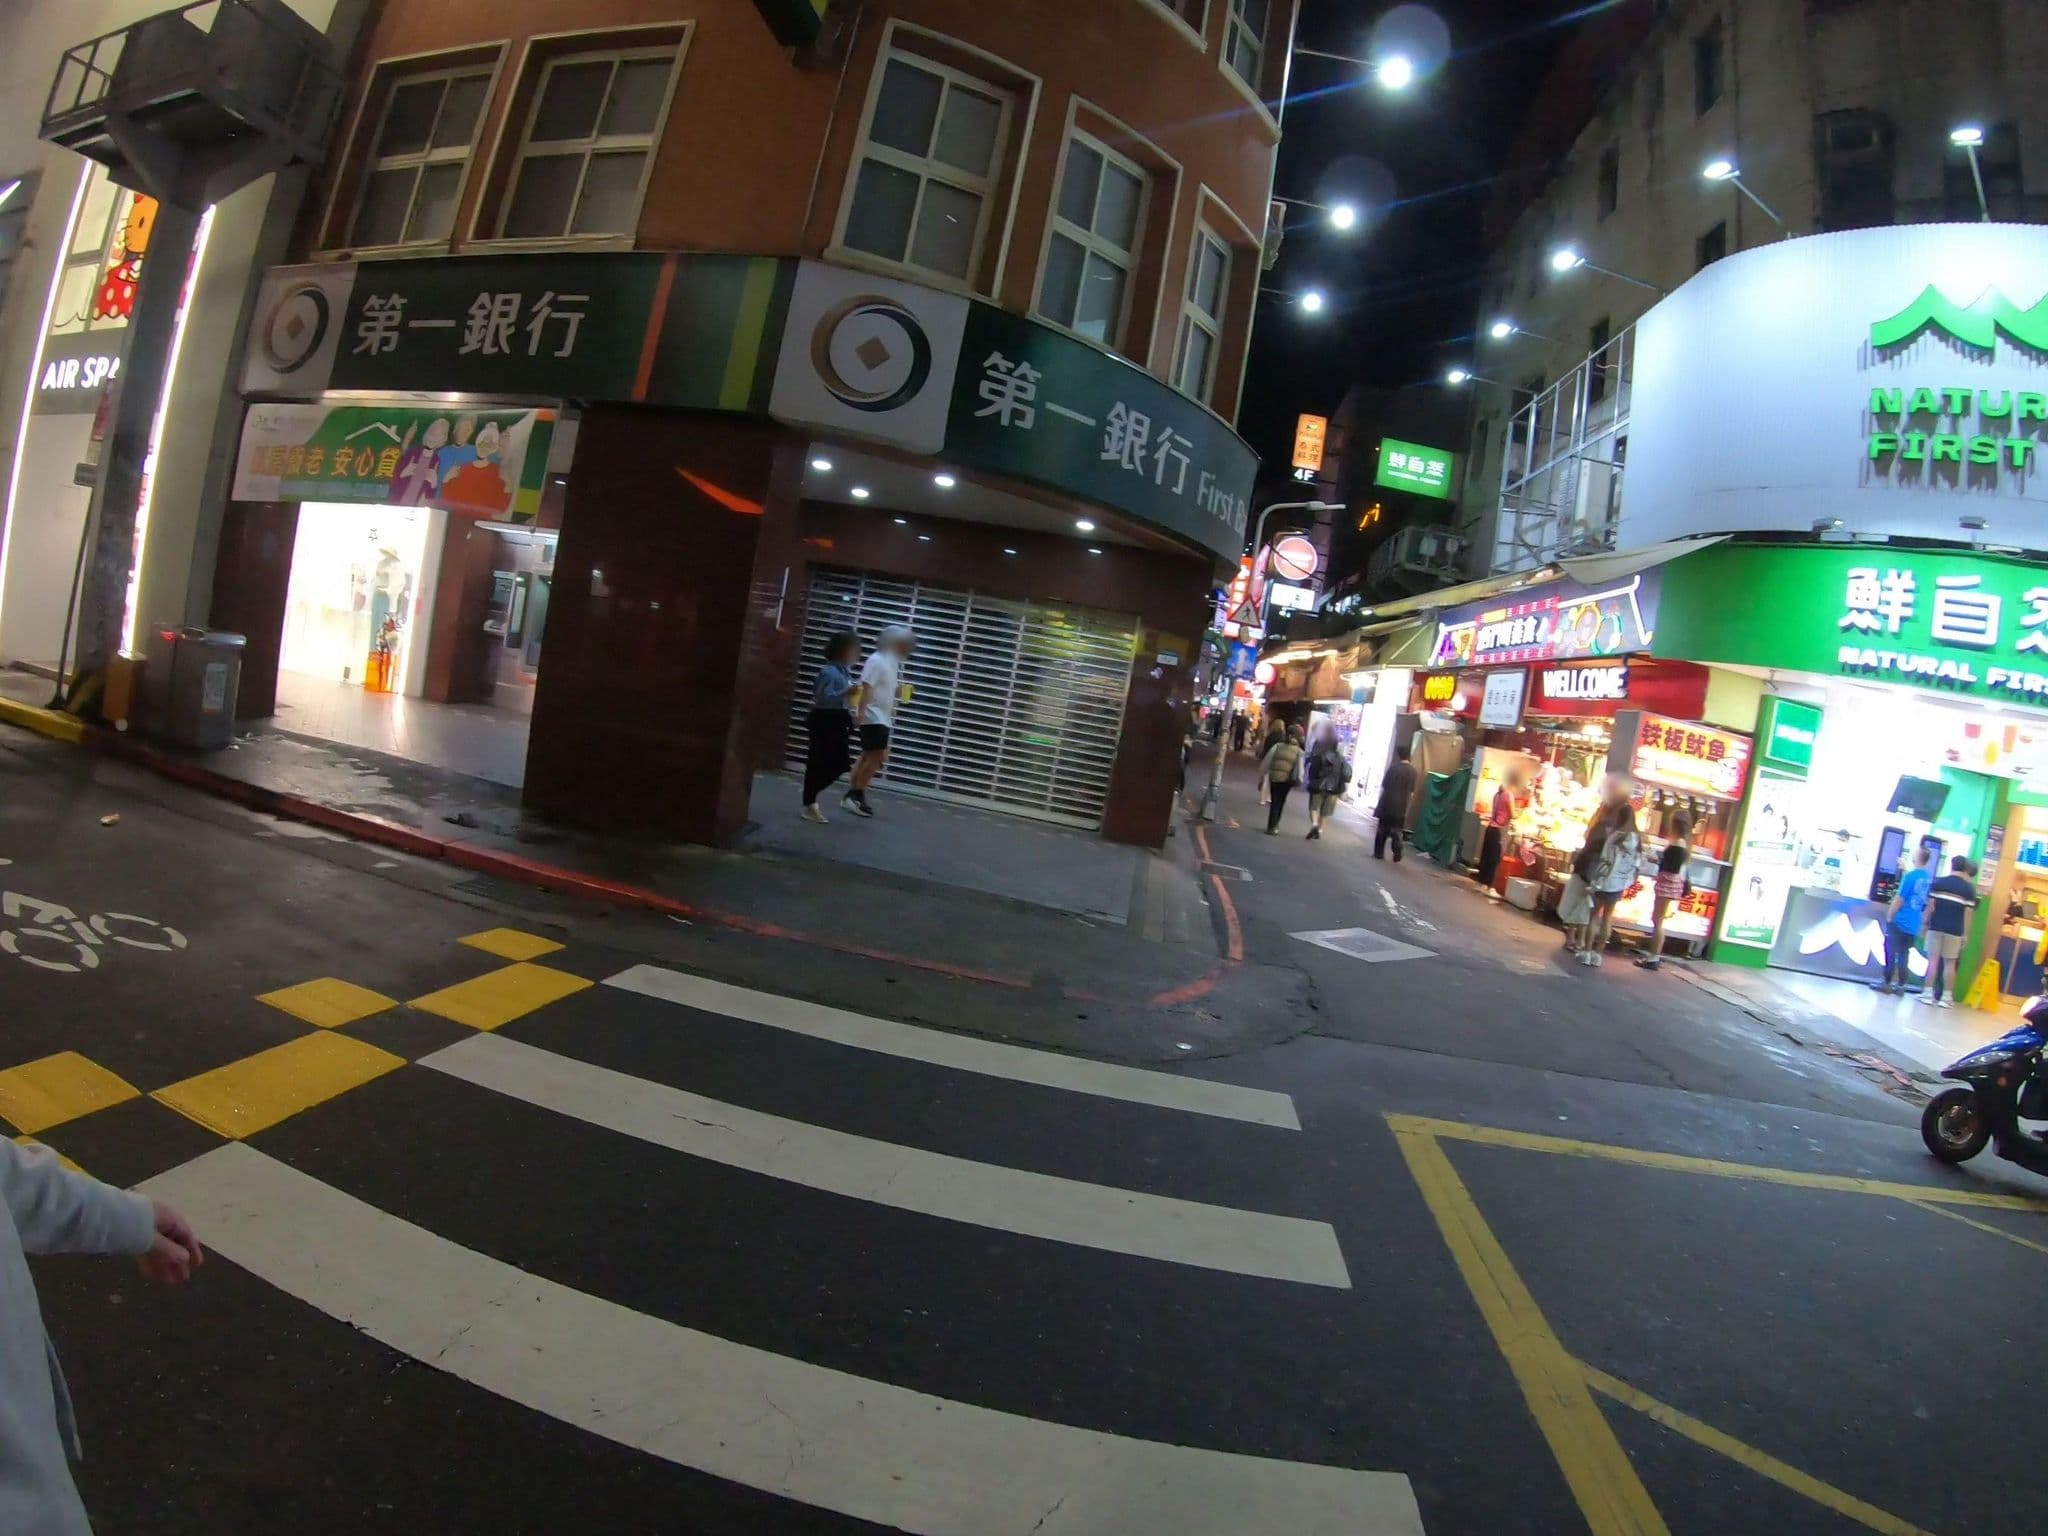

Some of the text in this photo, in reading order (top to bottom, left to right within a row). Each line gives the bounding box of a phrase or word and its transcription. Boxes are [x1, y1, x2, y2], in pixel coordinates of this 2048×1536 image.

[352, 291, 590, 359] 第一銀行
[41, 358, 80, 390] AIR
[1869, 387, 2048, 422] NATUR
[974, 350, 1194, 496] 第一銀行
[330, 446, 401, 480] 安心貸
[1868, 431, 2034, 468] FIRST
[1293, 467, 1316, 482] 4F
[1196, 469, 1234, 529] First
[1543, 667, 1627, 698] WELLCOME
[1838, 646, 1978, 683] NATURAL
